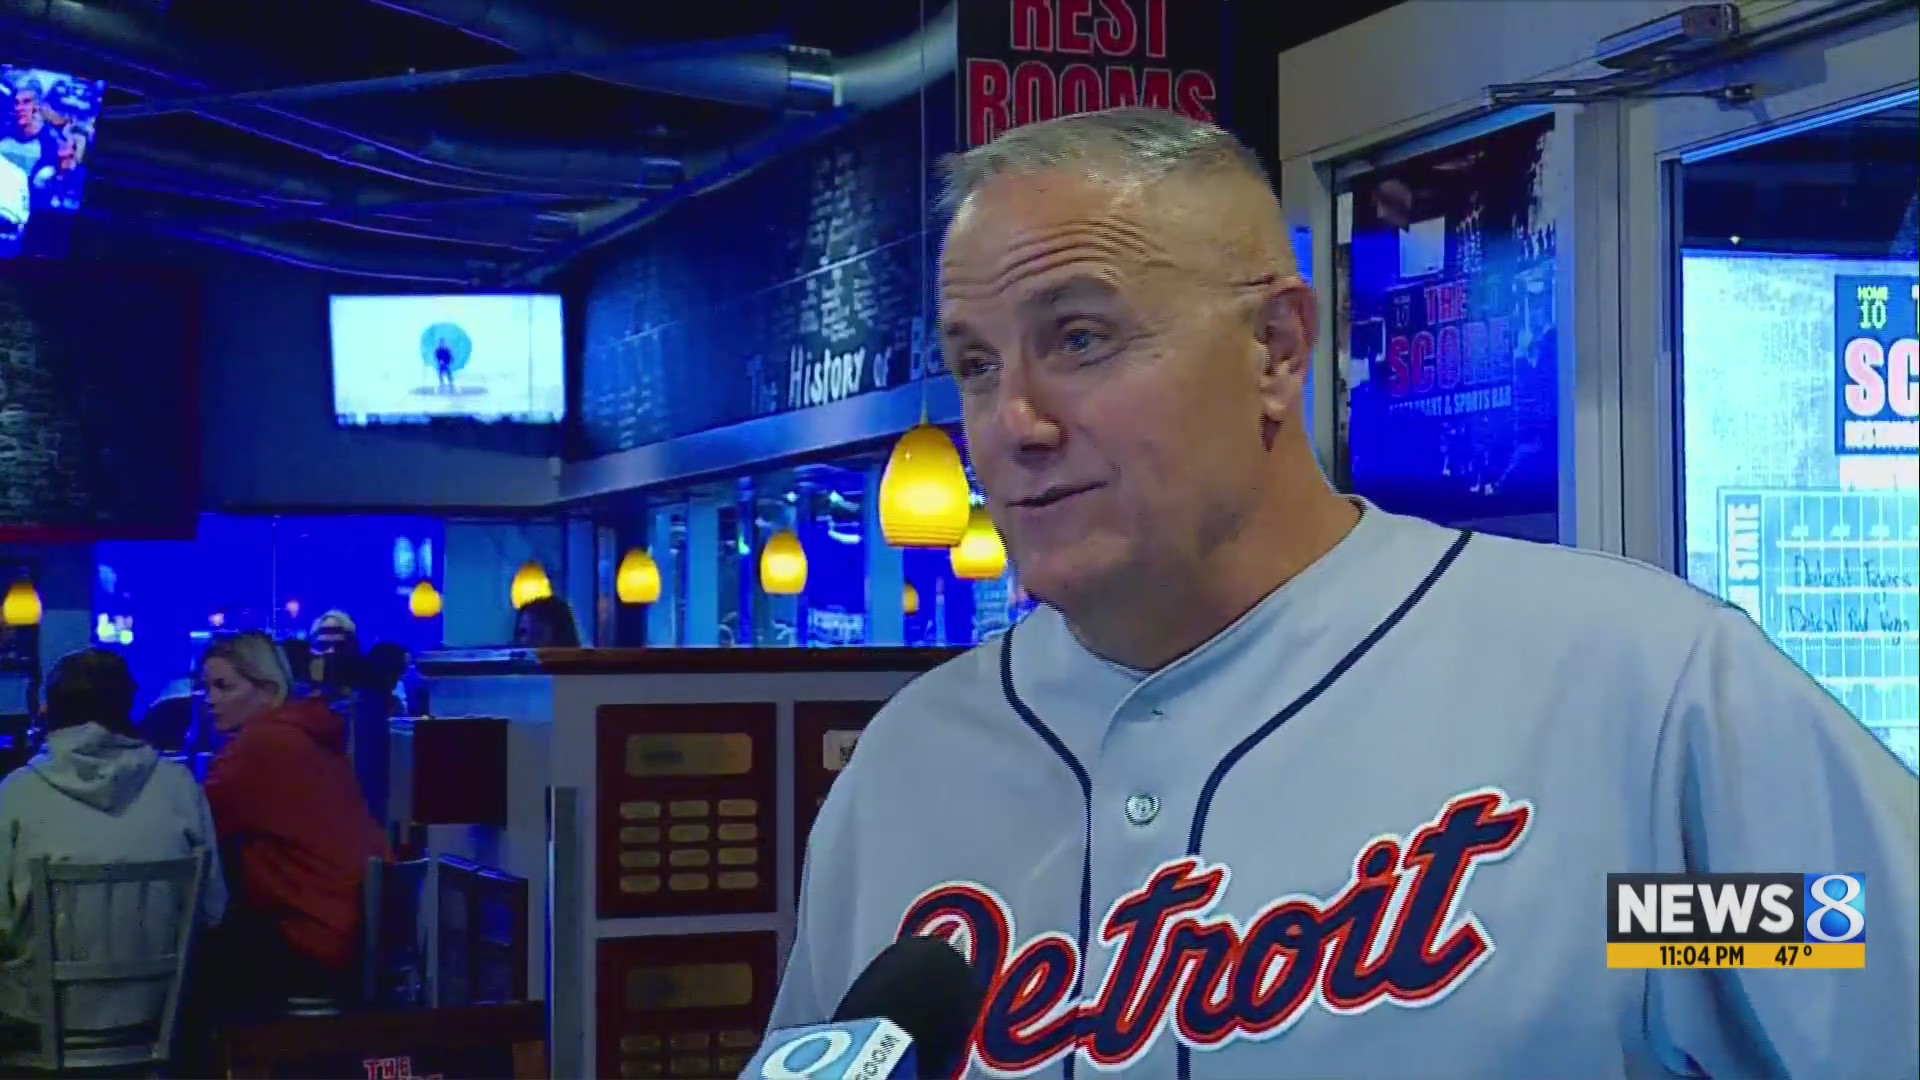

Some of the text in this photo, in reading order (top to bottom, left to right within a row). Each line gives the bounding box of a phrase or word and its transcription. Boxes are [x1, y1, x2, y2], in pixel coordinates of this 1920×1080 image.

[1859, 299, 1888, 329] 10
[1390, 316, 1513, 397] SCORE
[1727, 503, 1760, 580] STATE
[894, 787, 1532, 1080] Detroit
